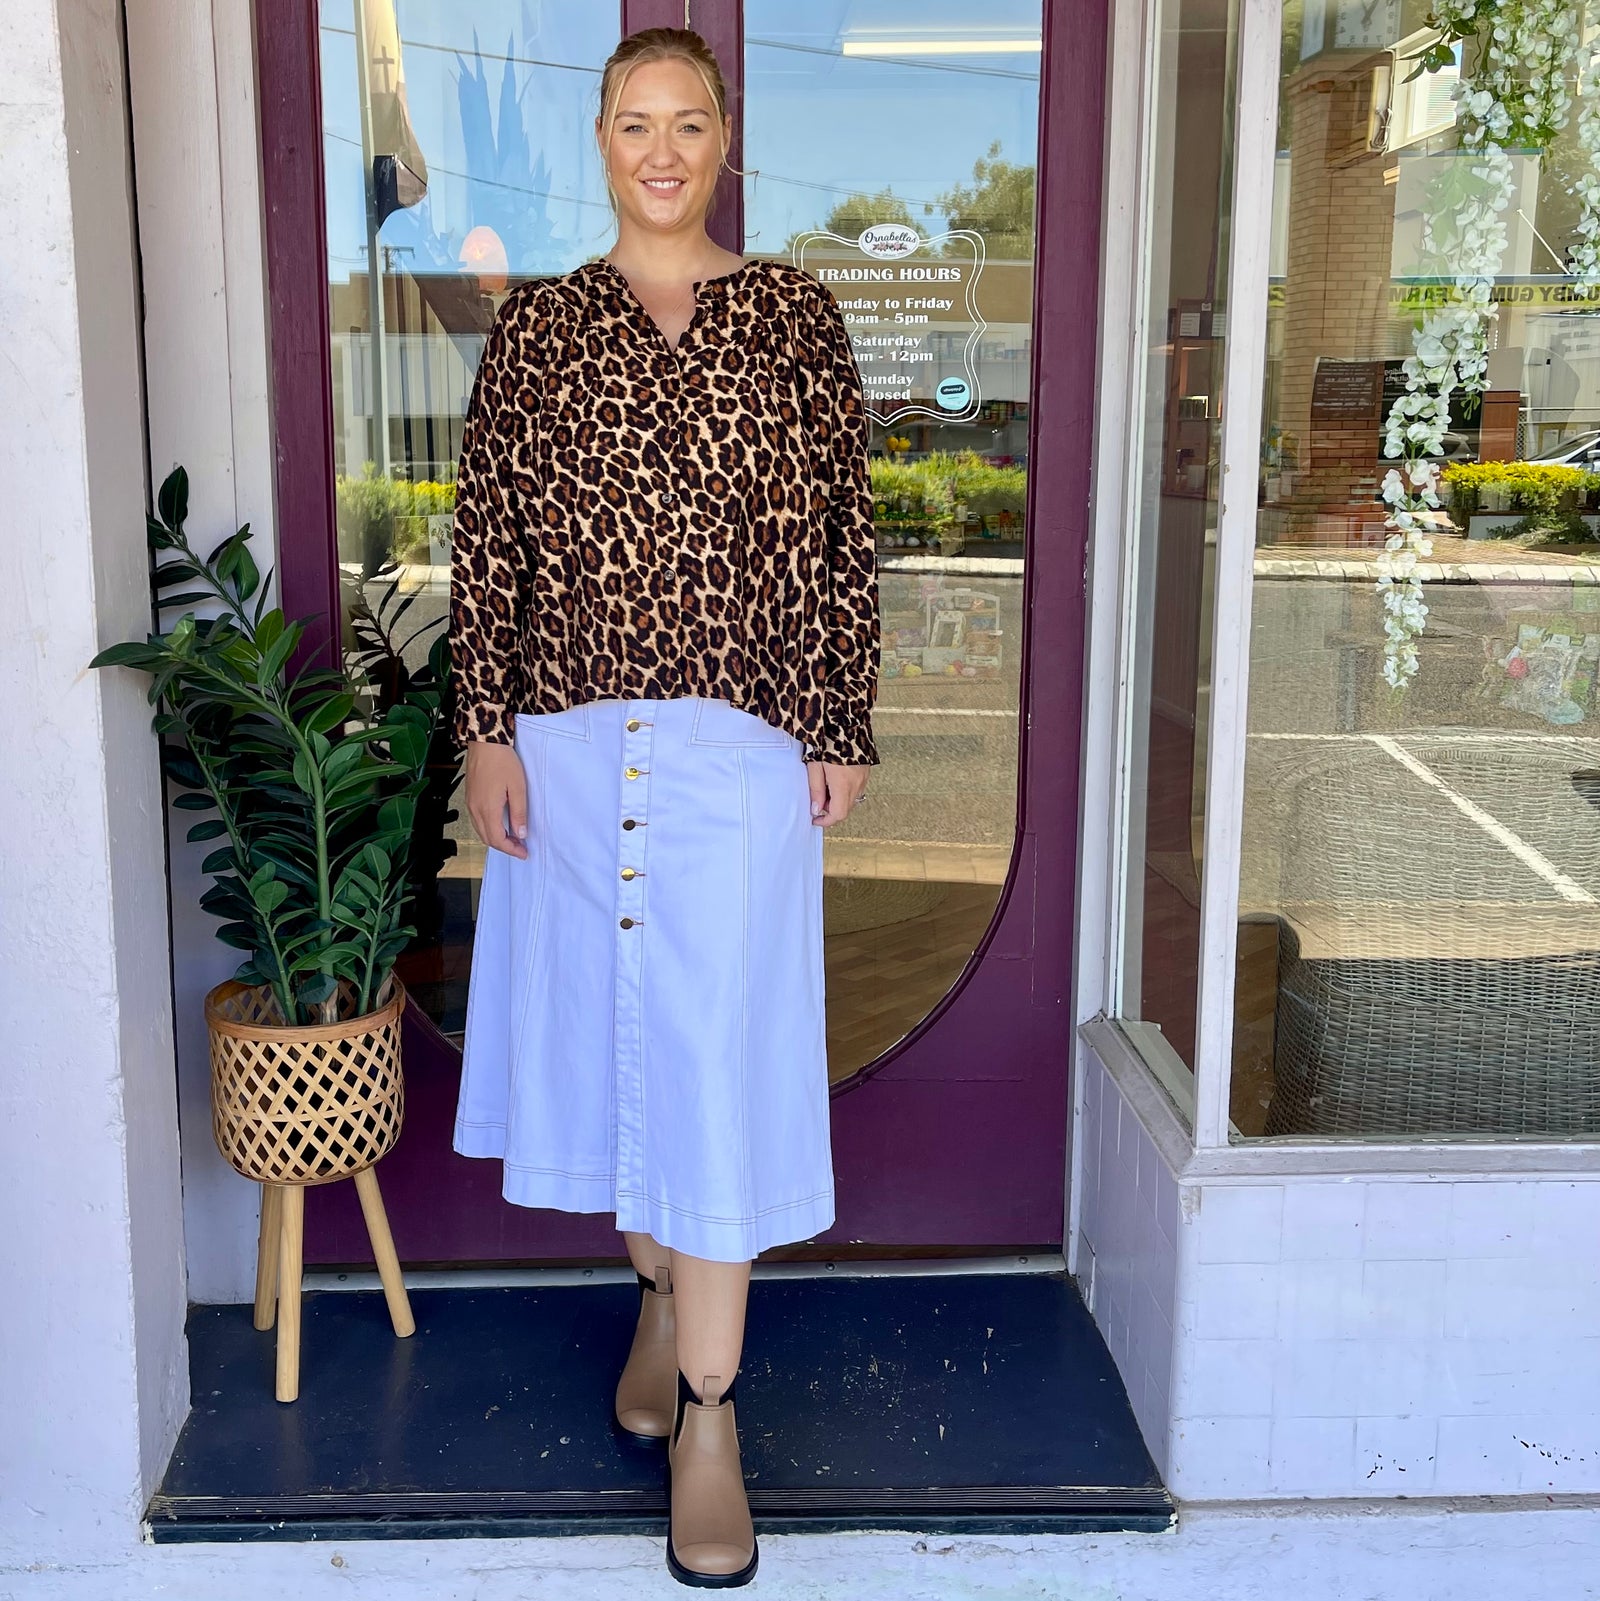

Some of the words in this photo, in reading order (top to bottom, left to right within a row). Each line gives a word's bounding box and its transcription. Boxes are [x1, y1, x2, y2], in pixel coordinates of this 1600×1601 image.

[865, 231, 916, 243] Ornabellas
[816, 268, 894, 281] TRADING
[900, 267, 962, 281] HOURS
[836, 297, 880, 311] onday
[885, 298, 900, 309] to
[905, 297, 954, 311] Friday
[845, 312, 879, 324] 9am
[894, 312, 929, 325] 5pm
[853, 335, 922, 348] Saturday
[890, 350, 934, 363] 12pm
[860, 373, 914, 387] Sunday
[863, 388, 911, 400] Closed
